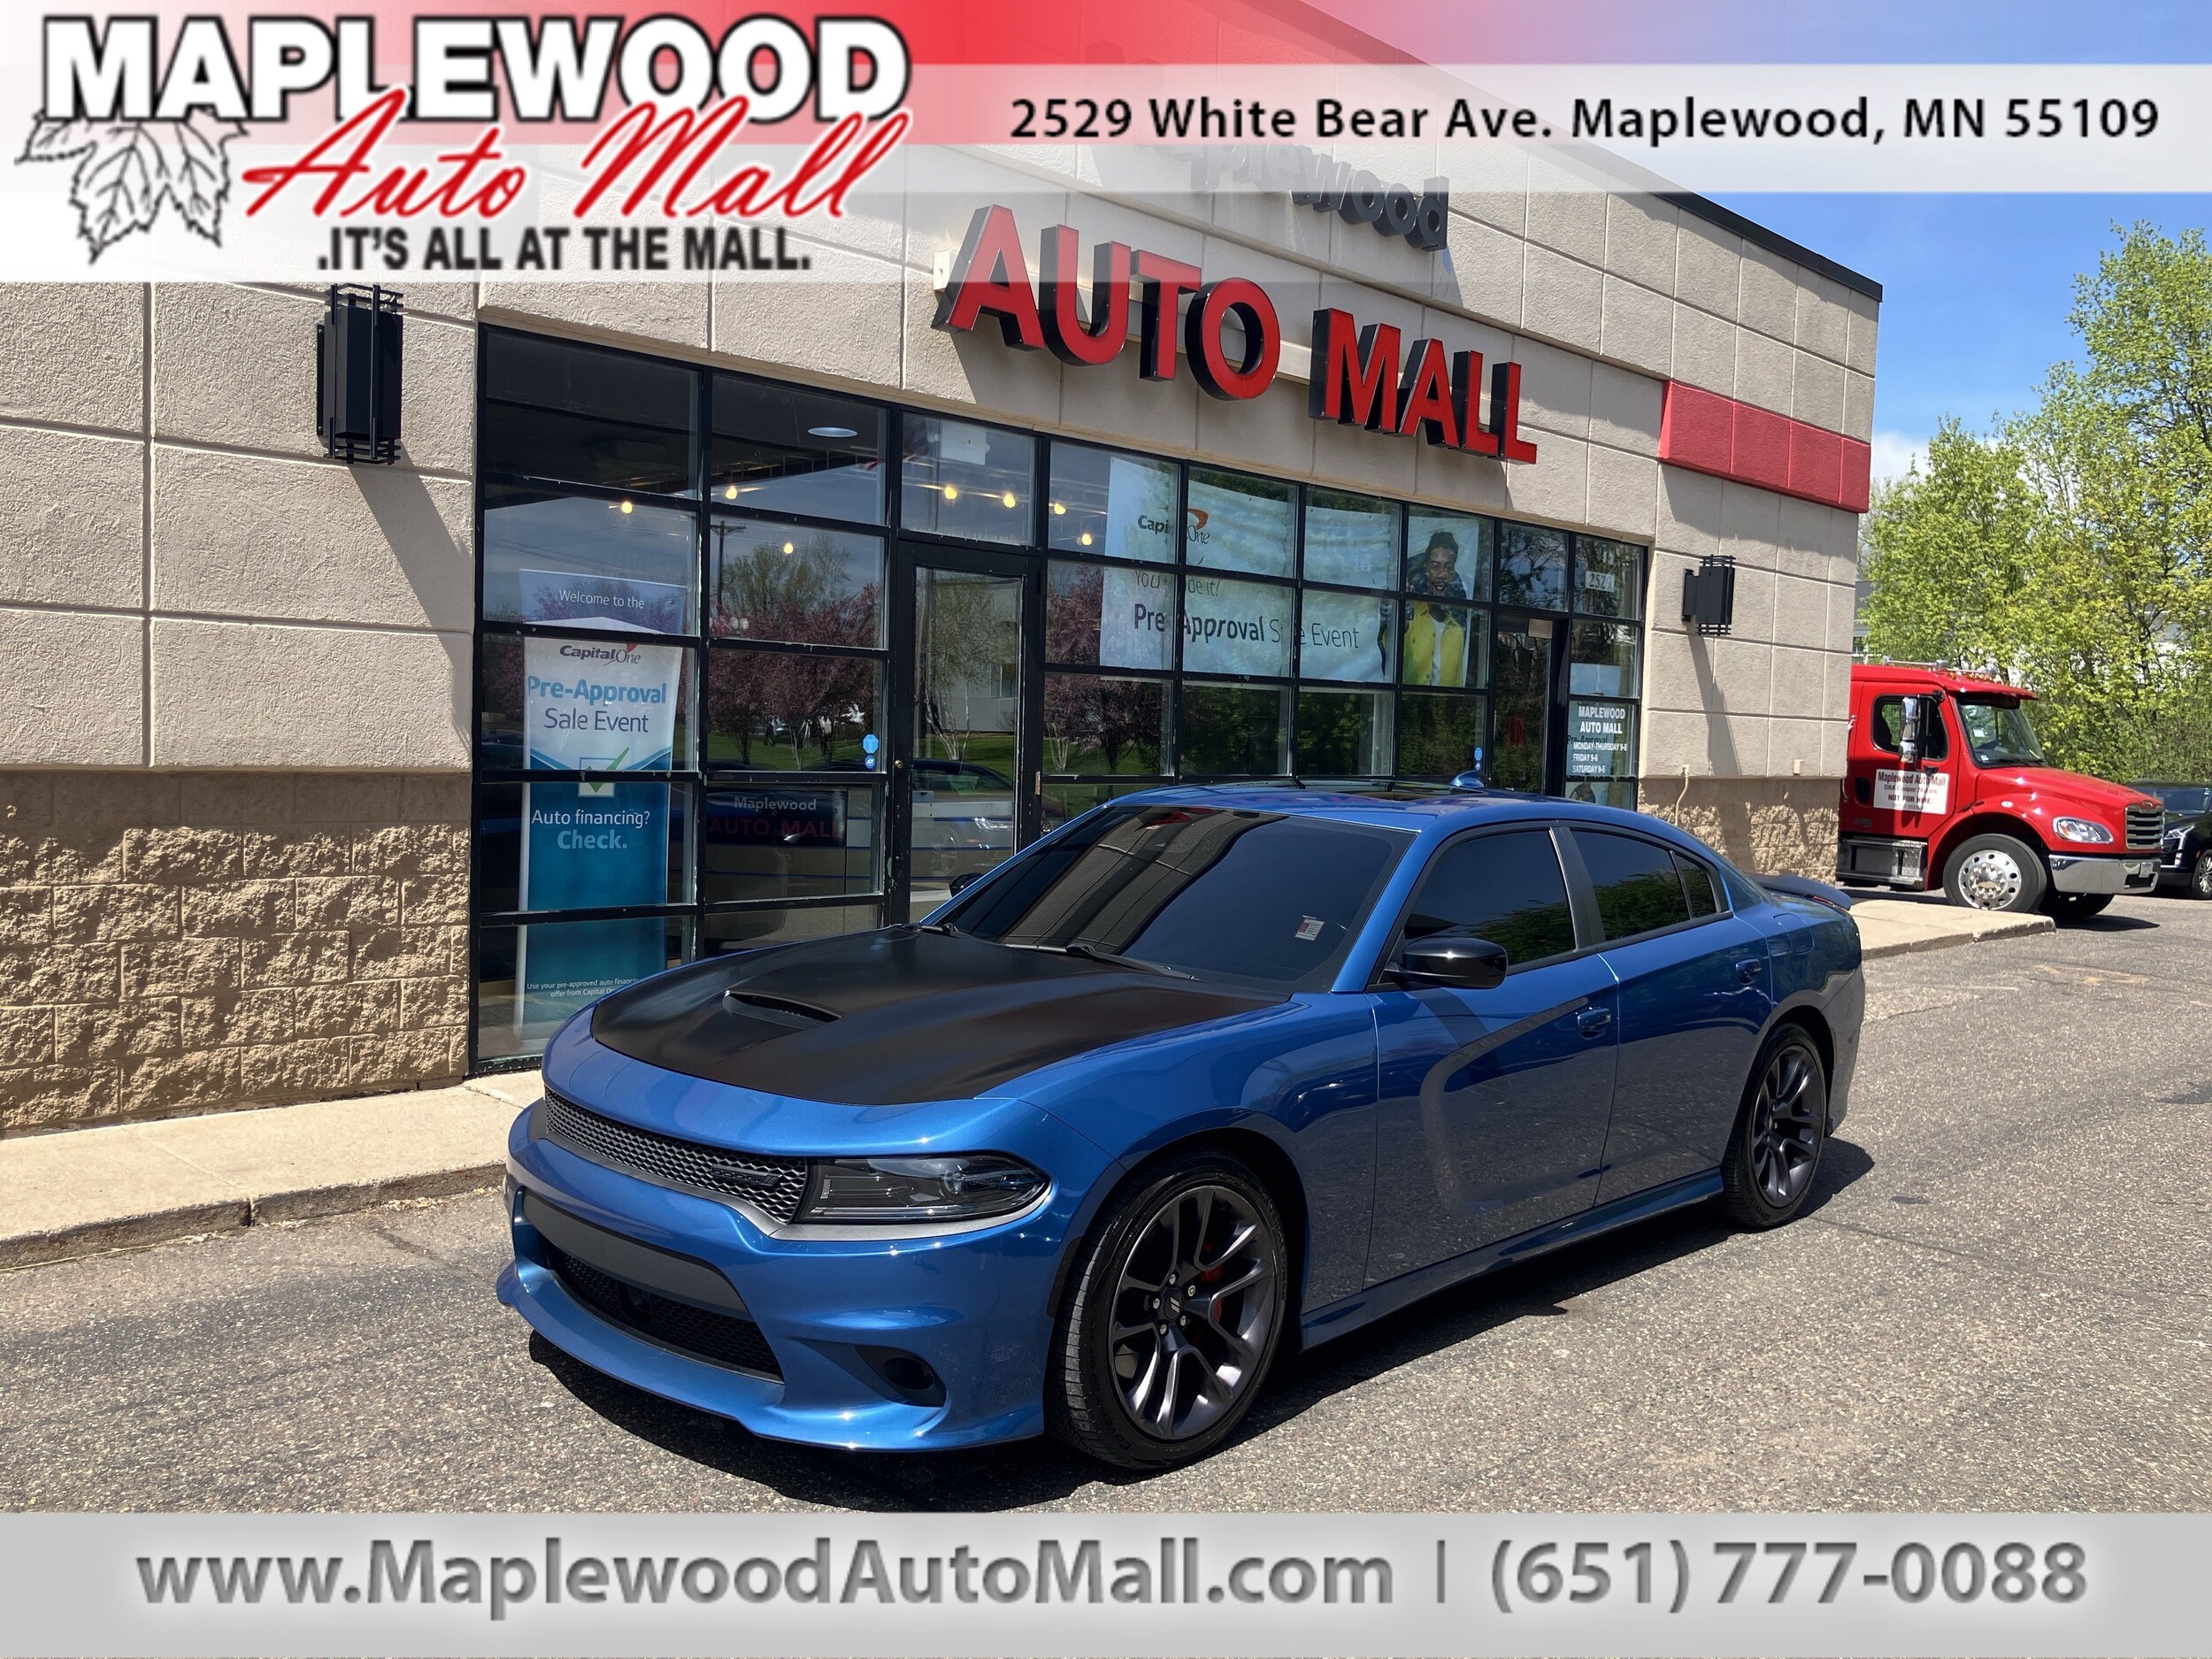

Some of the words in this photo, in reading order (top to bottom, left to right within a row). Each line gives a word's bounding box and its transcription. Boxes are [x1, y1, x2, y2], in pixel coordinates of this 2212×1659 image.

[938, 204, 1281, 402] AUTO
[1308, 306, 1538, 465] MALL
[1589, 574, 1612, 589] 2529
[559, 588, 610, 605] Welcome
[613, 596, 625, 606] to
[627, 595, 645, 609] the
[1311, 623, 1359, 649] Event
[527, 675, 666, 706] Pre-Approval
[1578, 705, 1626, 719] MAPLEWOOD
[544, 708, 588, 730] Sale
[594, 710, 649, 733] Event
[1579, 721, 1601, 733] AUTO
[1602, 722, 1623, 734] MALL
[1572, 753, 1590, 762] FRIDAY
[1571, 764, 1598, 773] SATURDAY
[1931, 776, 1946, 787] Mall
[733, 796, 818, 811] Maplewood
[531, 810, 571, 825] Auto
[575, 809, 650, 829] financing?
[708, 818, 771, 836] AUTO
[780, 819, 845, 839] MALL
[557, 829, 628, 849] Check.
[541, 984, 555, 993] your
[557, 979, 598, 990] pre-approved
[582, 987, 605, 997] Capital
